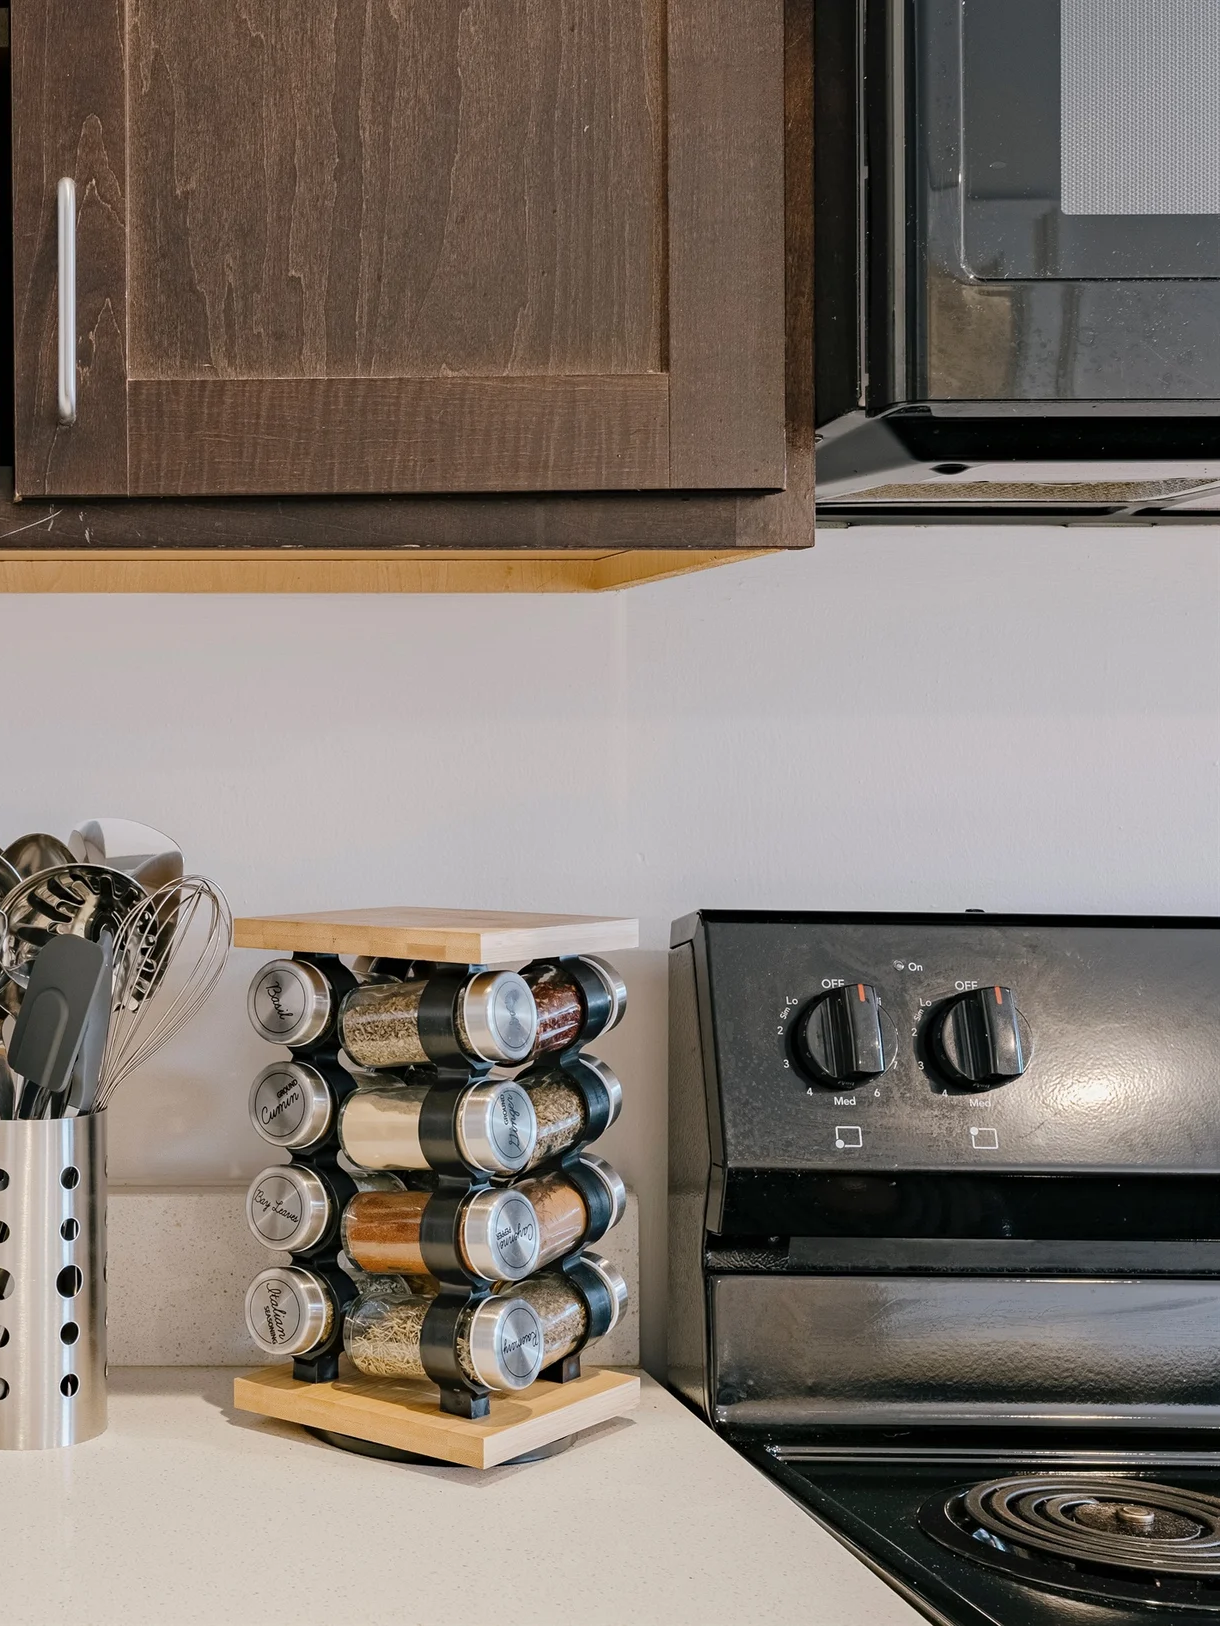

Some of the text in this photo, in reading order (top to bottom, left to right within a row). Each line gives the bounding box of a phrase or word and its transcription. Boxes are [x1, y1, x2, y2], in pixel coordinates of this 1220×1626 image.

[908, 962, 923, 972] On
[821, 979, 845, 989] OFF
[954, 980, 979, 991] OFF
[266, 981, 293, 1020] Basil
[786, 996, 799, 1005] Lo
[920, 998, 932, 1007] Lo
[777, 1026, 784, 1036] 2
[911, 1028, 918, 1037] 2
[783, 1059, 790, 1069] 3
[918, 1061, 925, 1071] 3
[276, 1078, 299, 1100] GROUND
[806, 1087, 814, 1097] 4
[874, 1088, 881, 1098] 6
[942, 1089, 949, 1099] 4
[833, 1096, 857, 1107] Med
[969, 1098, 992, 1108] Med
[261, 1091, 300, 1125] Cumin
[500, 1094, 509, 1125] GROUND
[508, 1094, 522, 1152] Ginger
[254, 1189, 299, 1223] Bay Leaves
[265, 1282, 288, 1341] Italian
[264, 1305, 279, 1346] SEASONING
[503, 1329, 539, 1356] Rosemary
